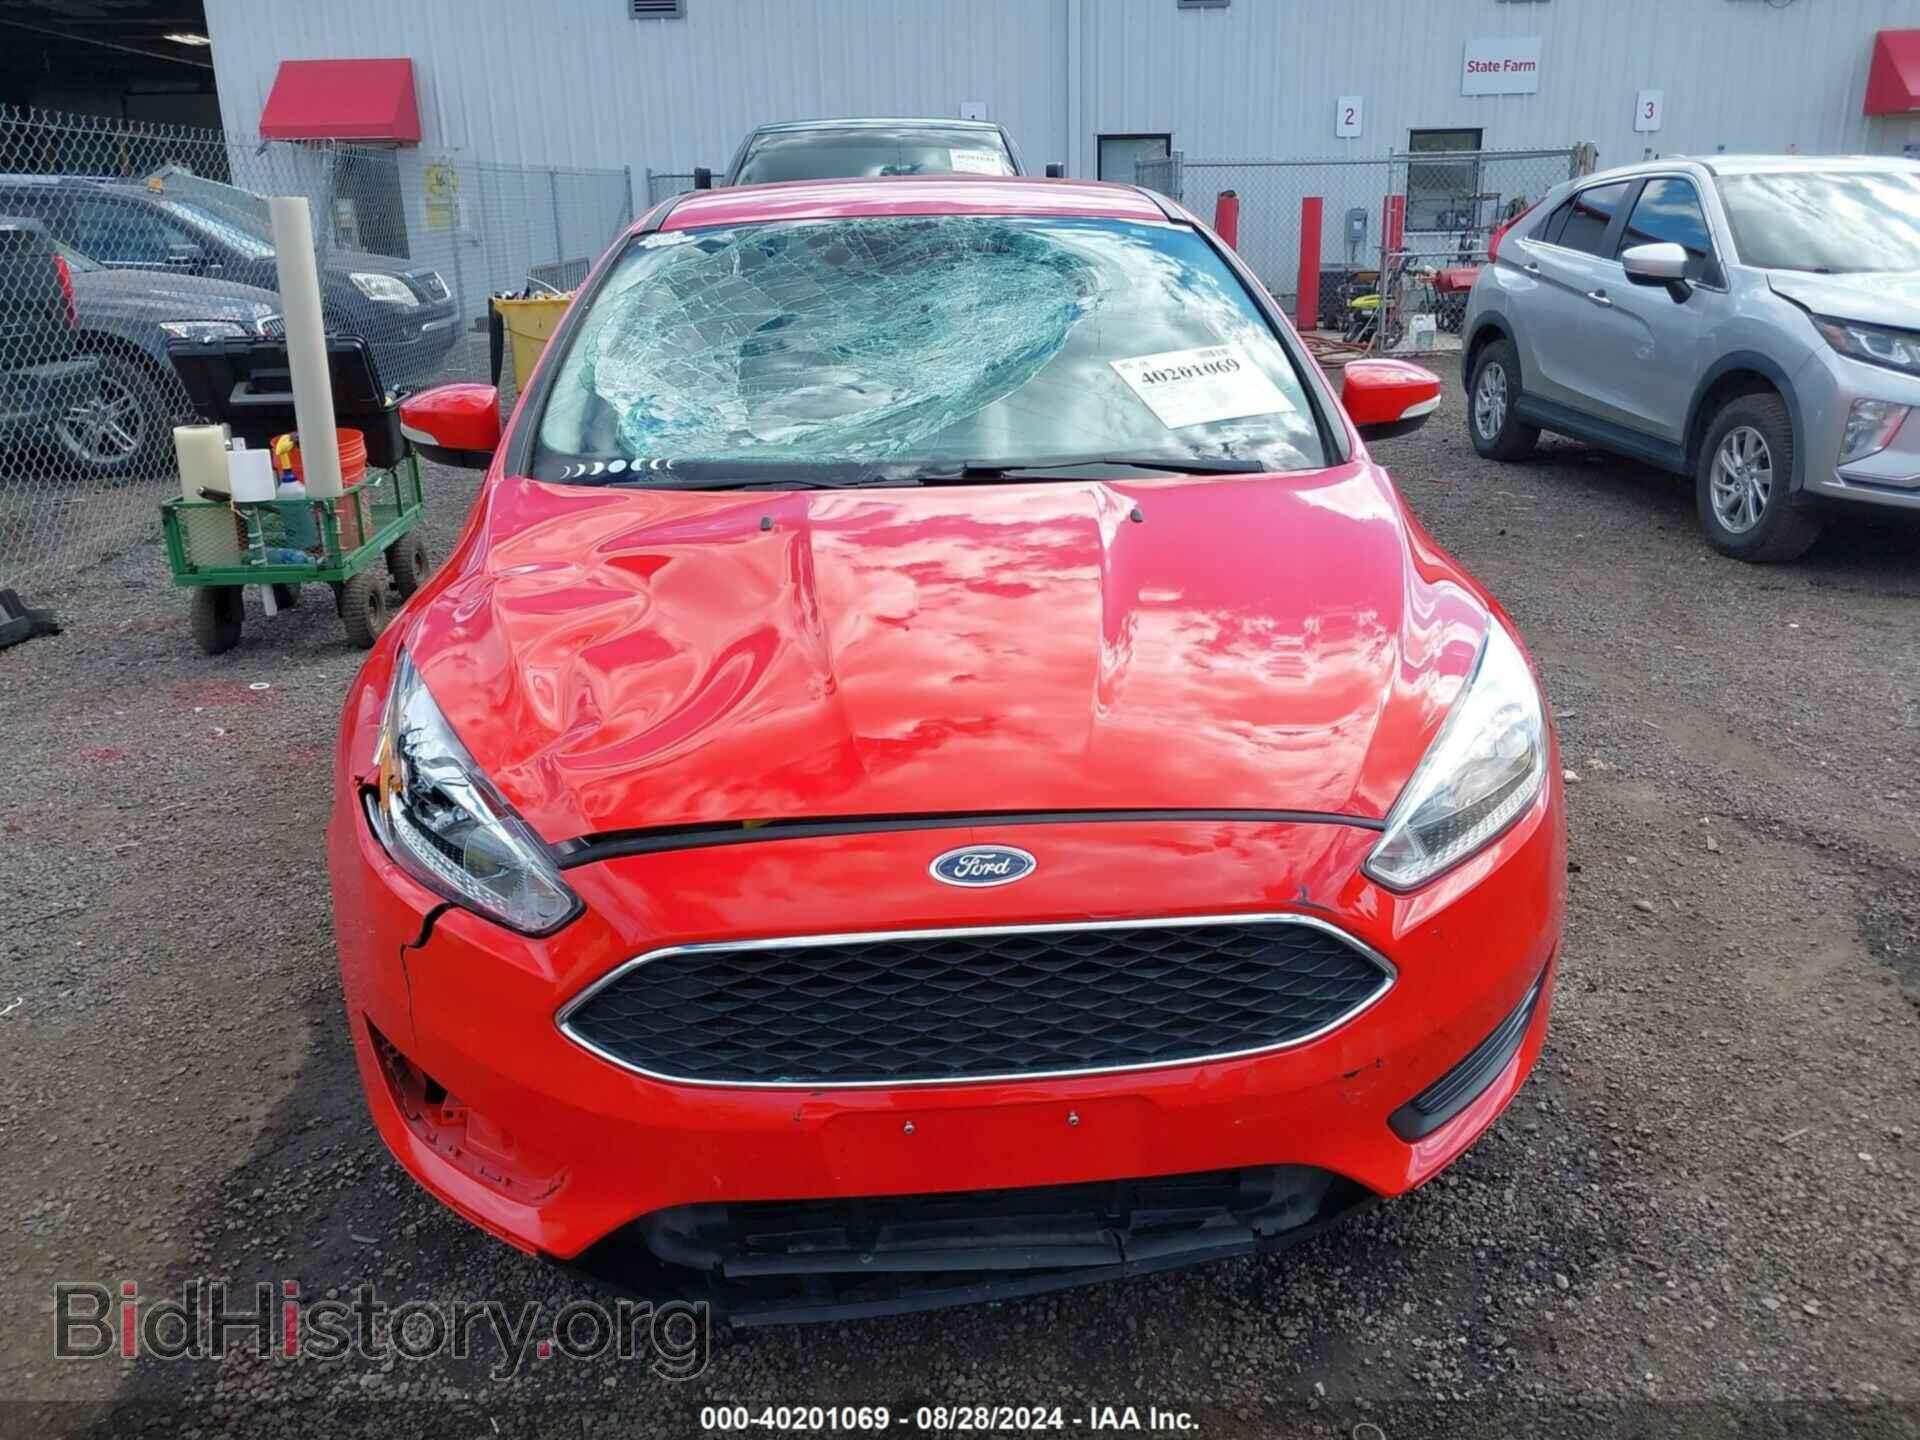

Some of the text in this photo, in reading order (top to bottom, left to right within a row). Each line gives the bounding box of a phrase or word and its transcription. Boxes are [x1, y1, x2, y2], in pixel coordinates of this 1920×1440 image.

[1467, 60, 1536, 73] State Farm
[1344, 107, 1355, 126] 2
[1644, 101, 1654, 119] 3
[1141, 358, 1240, 384] 40201069
[954, 853, 1010, 877] Ford
